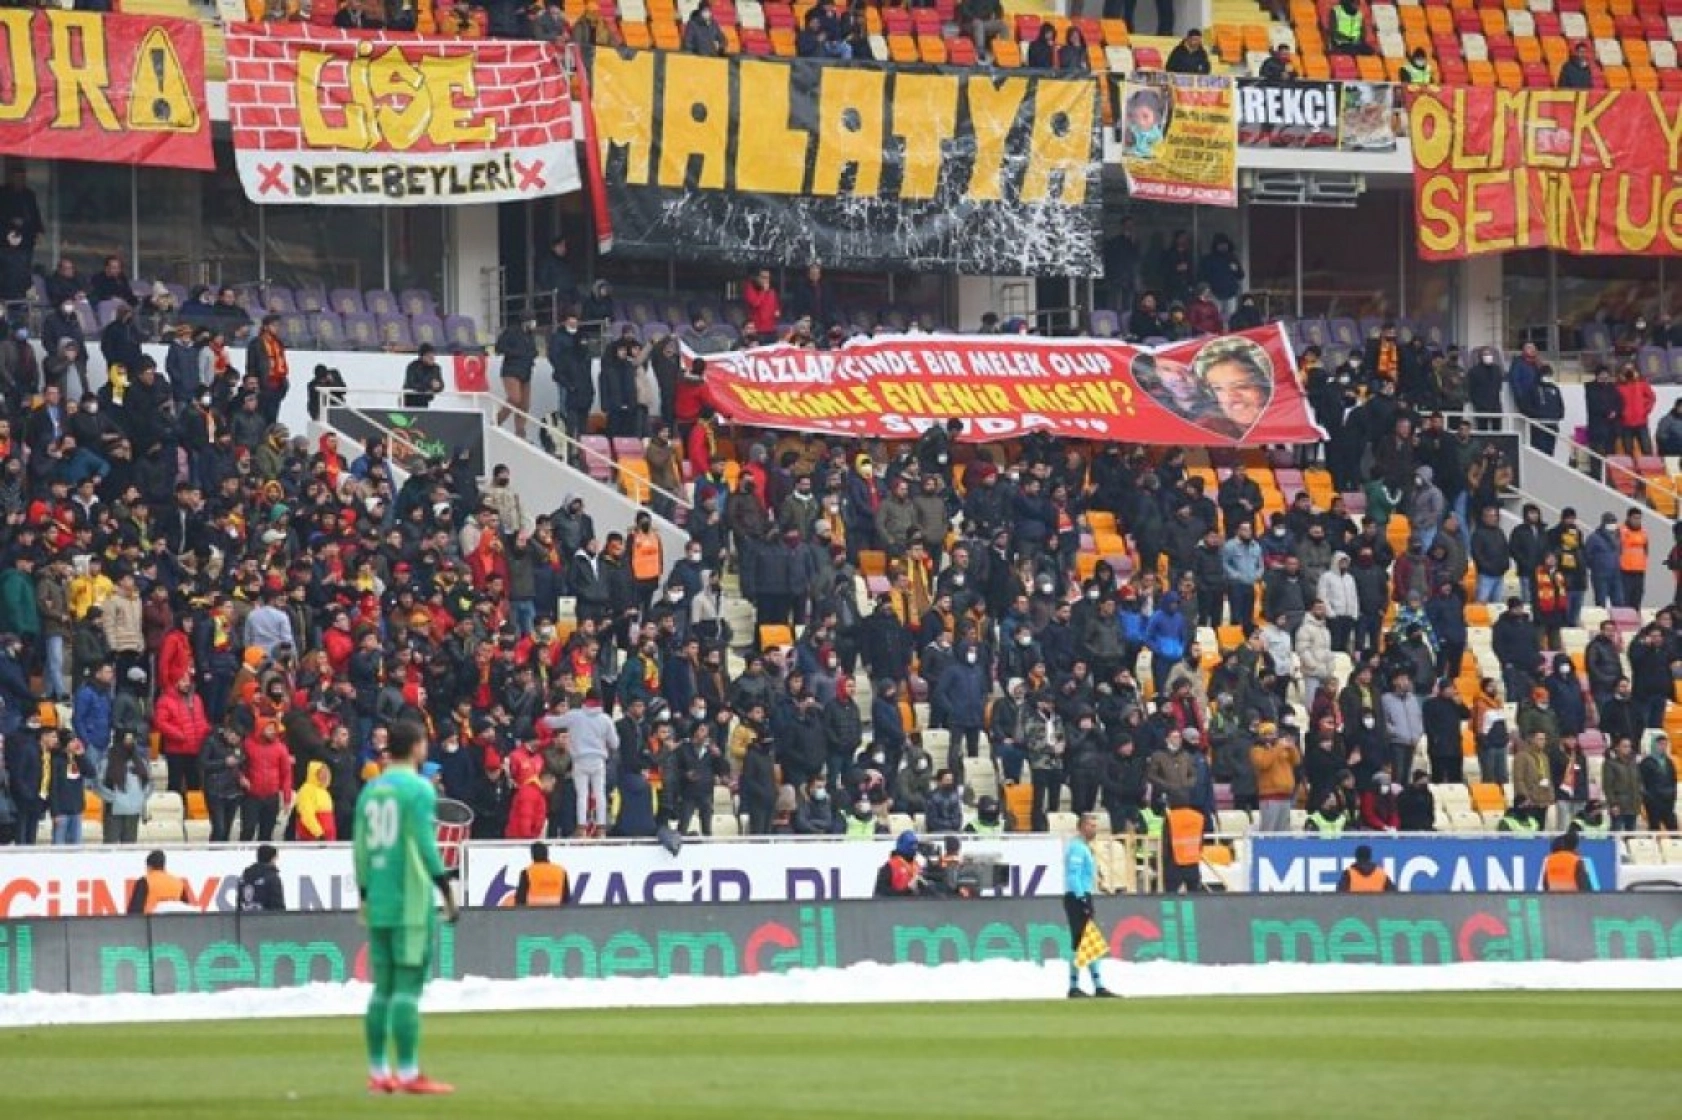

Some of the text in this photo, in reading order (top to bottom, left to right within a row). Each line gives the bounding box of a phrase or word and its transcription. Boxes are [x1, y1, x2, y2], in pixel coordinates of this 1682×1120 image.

[593, 46, 1097, 204] MALATYA
[1408, 83, 1620, 170] ÖLMEK
[292, 153, 516, 198] DEREBEYLERİ
[967, 350, 1050, 377] MELEK
[1048, 352, 1112, 376] OLUP
[364, 797, 399, 850] 30
